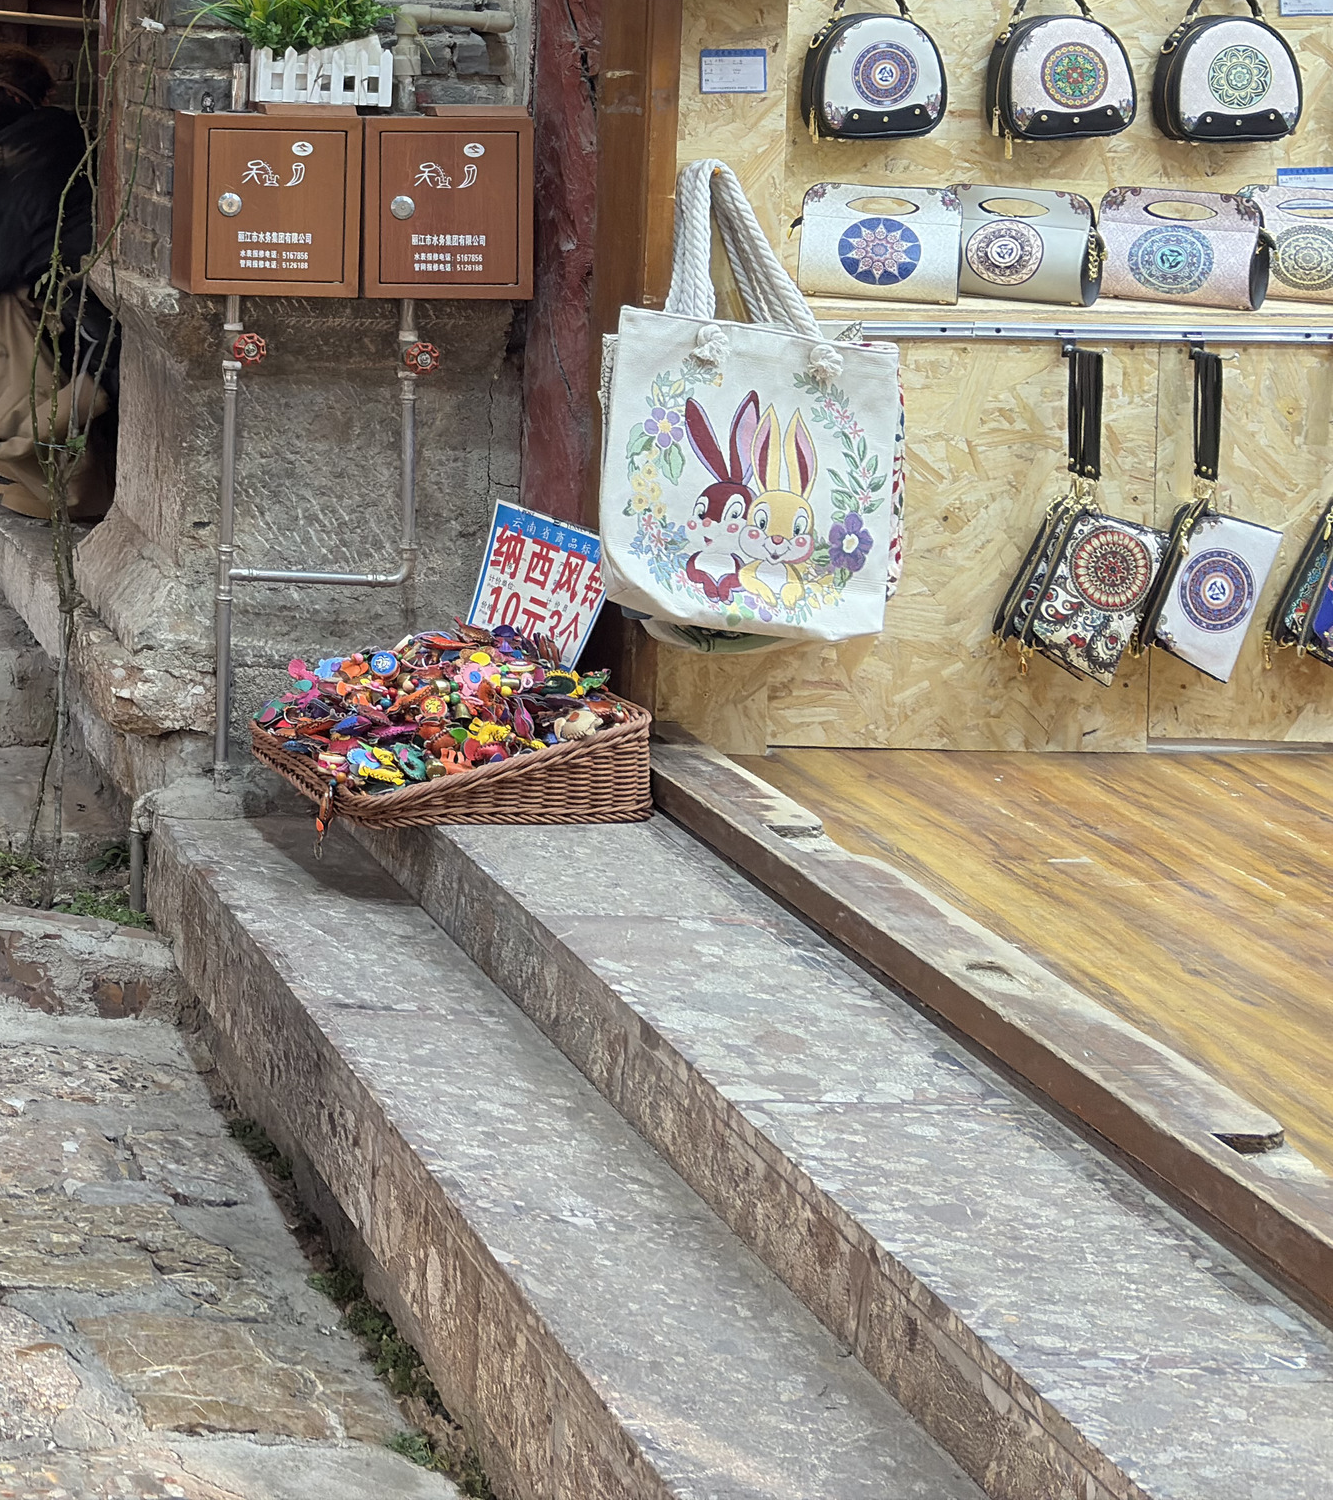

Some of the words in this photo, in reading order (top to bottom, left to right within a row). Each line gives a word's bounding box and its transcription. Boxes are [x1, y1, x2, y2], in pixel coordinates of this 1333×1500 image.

[237, 231, 312, 244] 丽江市水务集团有限公司
[411, 234, 486, 247] 丽江市水务集团有限公司
